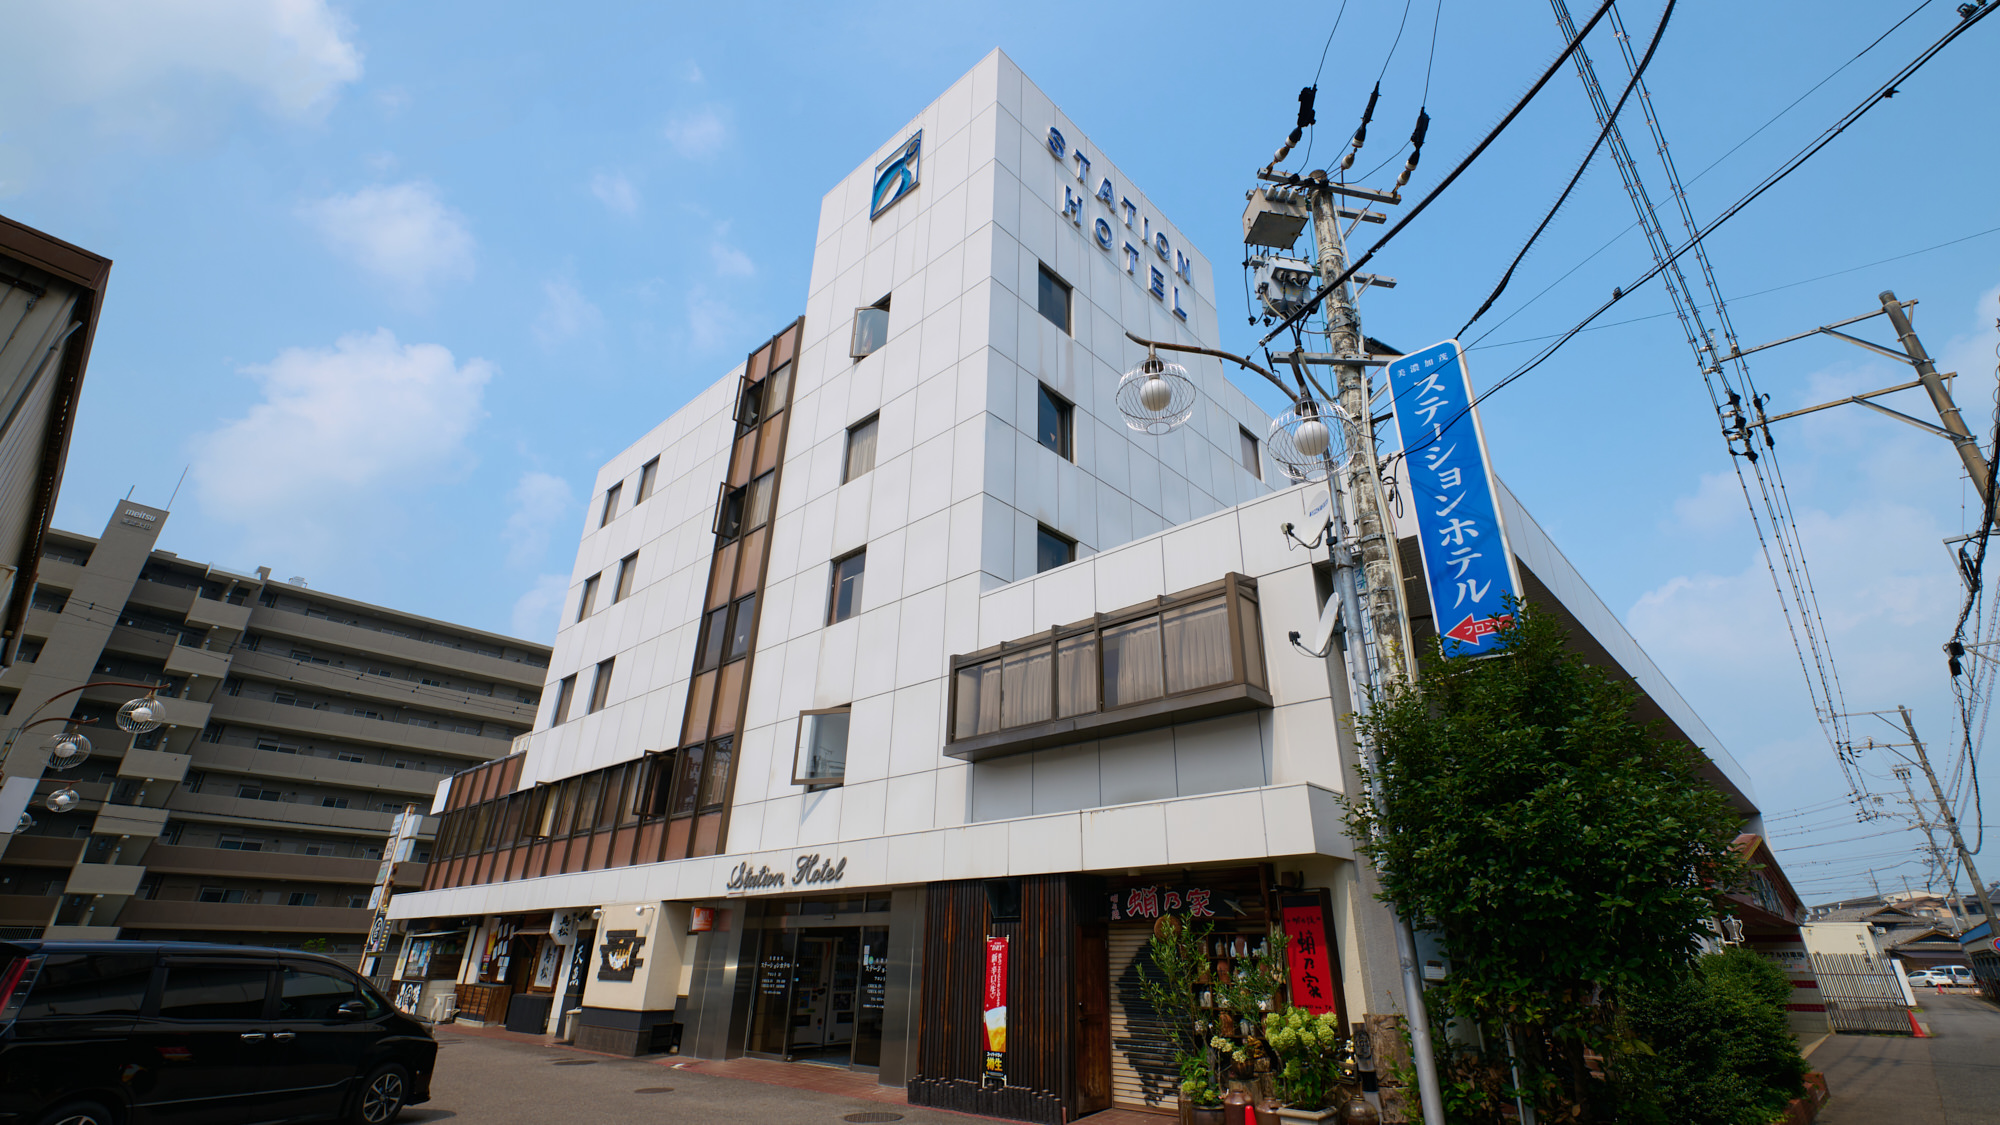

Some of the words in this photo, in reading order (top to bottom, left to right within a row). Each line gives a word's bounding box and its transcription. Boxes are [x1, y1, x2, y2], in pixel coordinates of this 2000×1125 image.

[1045, 126, 1192, 285] STATION
[1061, 184, 1188, 321] HOTEL
[1413, 373, 1492, 609] ステーションホテル
[727, 861, 785, 890] Station
[792, 853, 847, 885] Hotel
